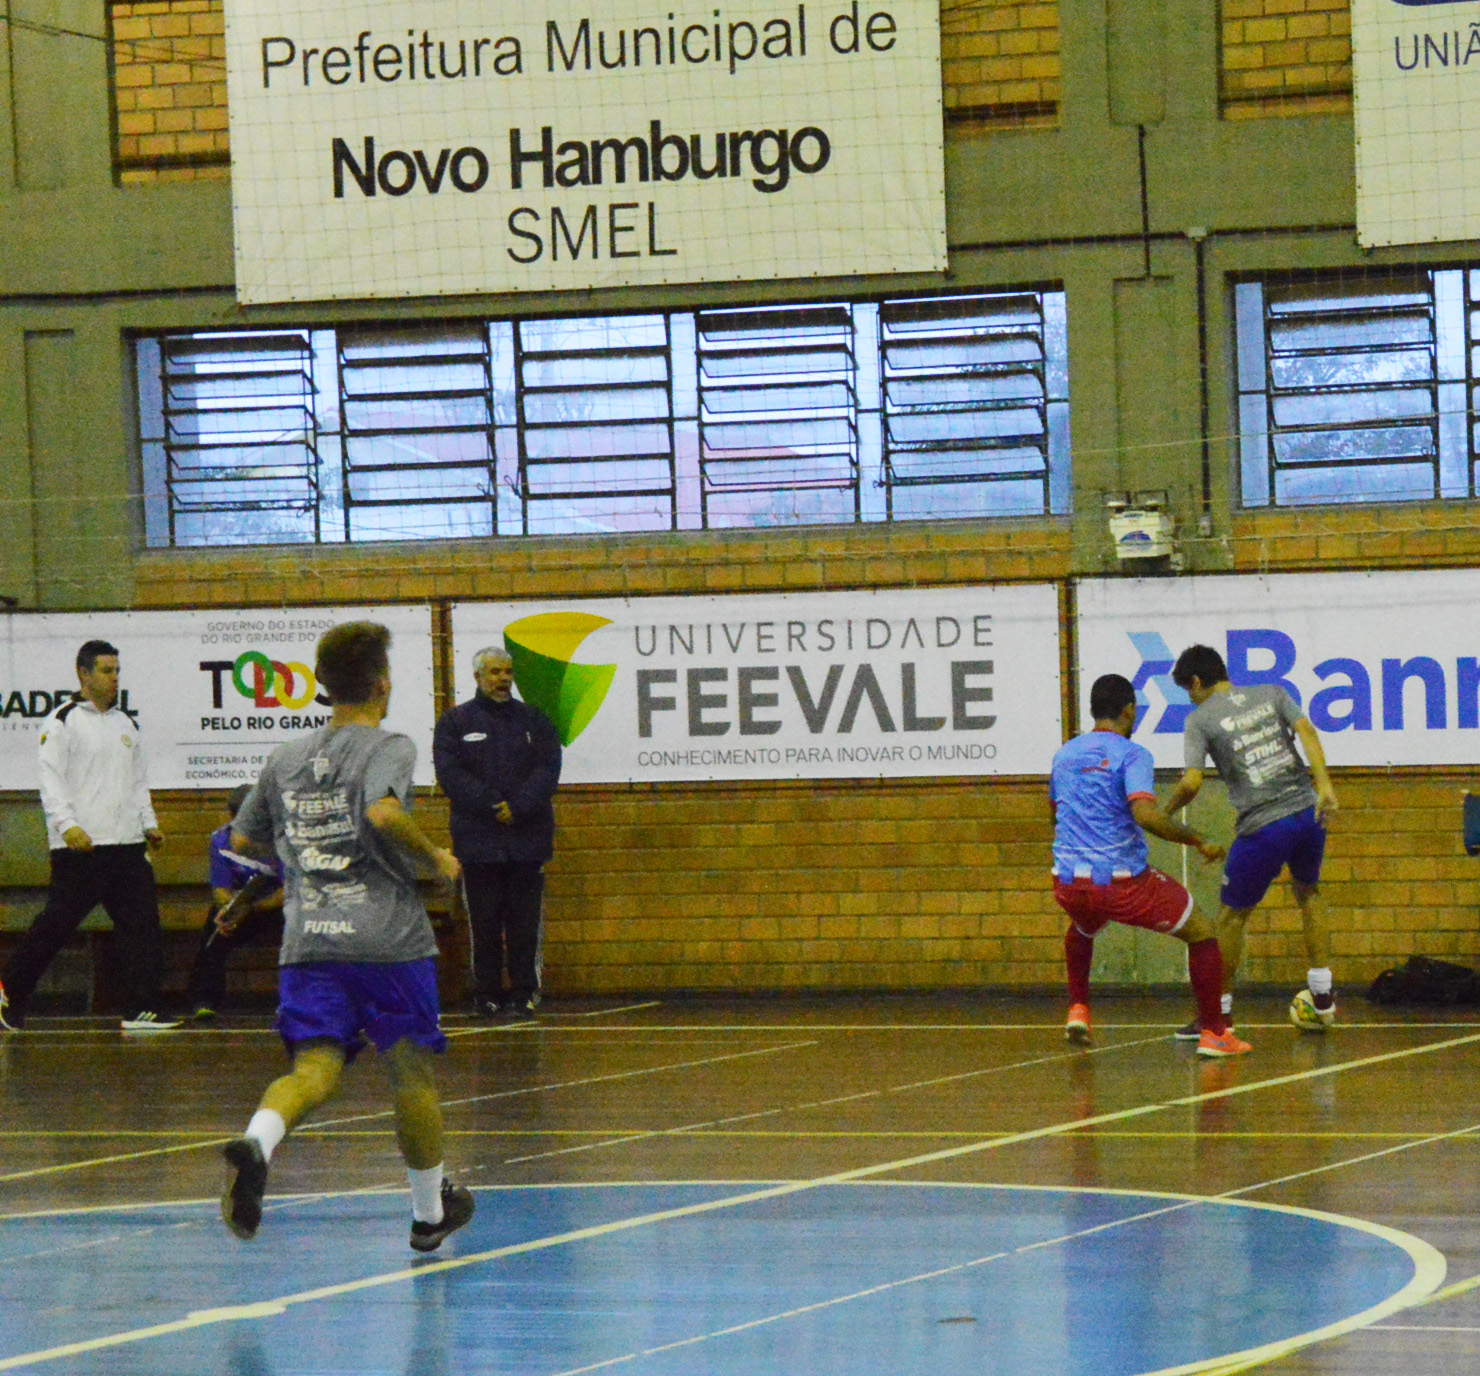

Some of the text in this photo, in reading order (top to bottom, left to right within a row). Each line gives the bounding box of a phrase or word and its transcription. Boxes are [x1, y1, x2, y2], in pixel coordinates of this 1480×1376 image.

[261, 2, 897, 88] Prefeitura Municipal de
[332, 121, 832, 199] Novo Hamburgo
[506, 202, 678, 263] SMEL
[207, 619, 335, 632] GOVERNO DO ESTADO
[634, 615, 995, 656] UNIVERSIDADE
[201, 632, 316, 644] DO RIO GRANDE DO
[636, 660, 997, 738] FEEVALE
[201, 715, 333, 730] PELO RIO GRAN
[188, 756, 248, 765] SECRETARIA
[638, 744, 997, 767] CONHECIMENTO PARA INOVAR O MUNDO
[304, 920, 357, 934] FUTSAL
